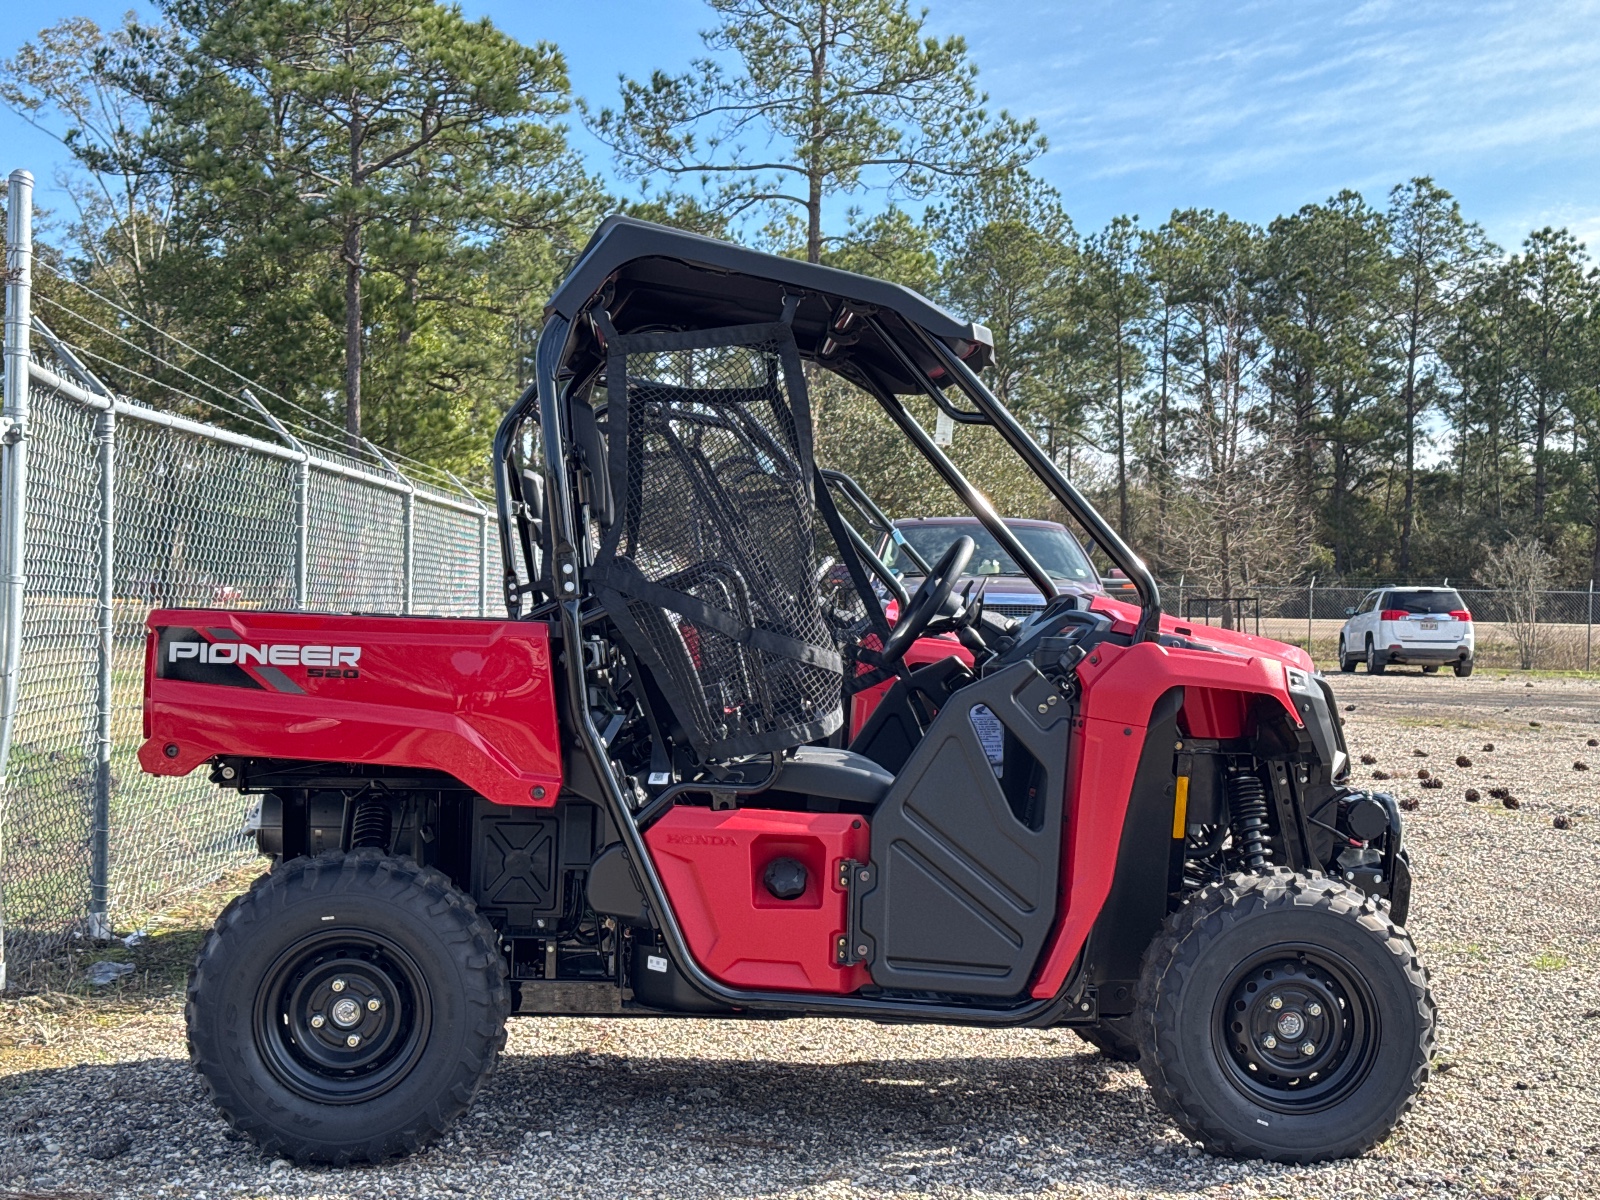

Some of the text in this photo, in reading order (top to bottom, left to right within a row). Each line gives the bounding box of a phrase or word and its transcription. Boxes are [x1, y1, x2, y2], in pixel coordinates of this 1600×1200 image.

[168, 641, 362, 667] PIONEER
[307, 668, 359, 679] 520
[666, 834, 738, 846] HONDA
[225, 1002, 322, 1127] MAXXIS
